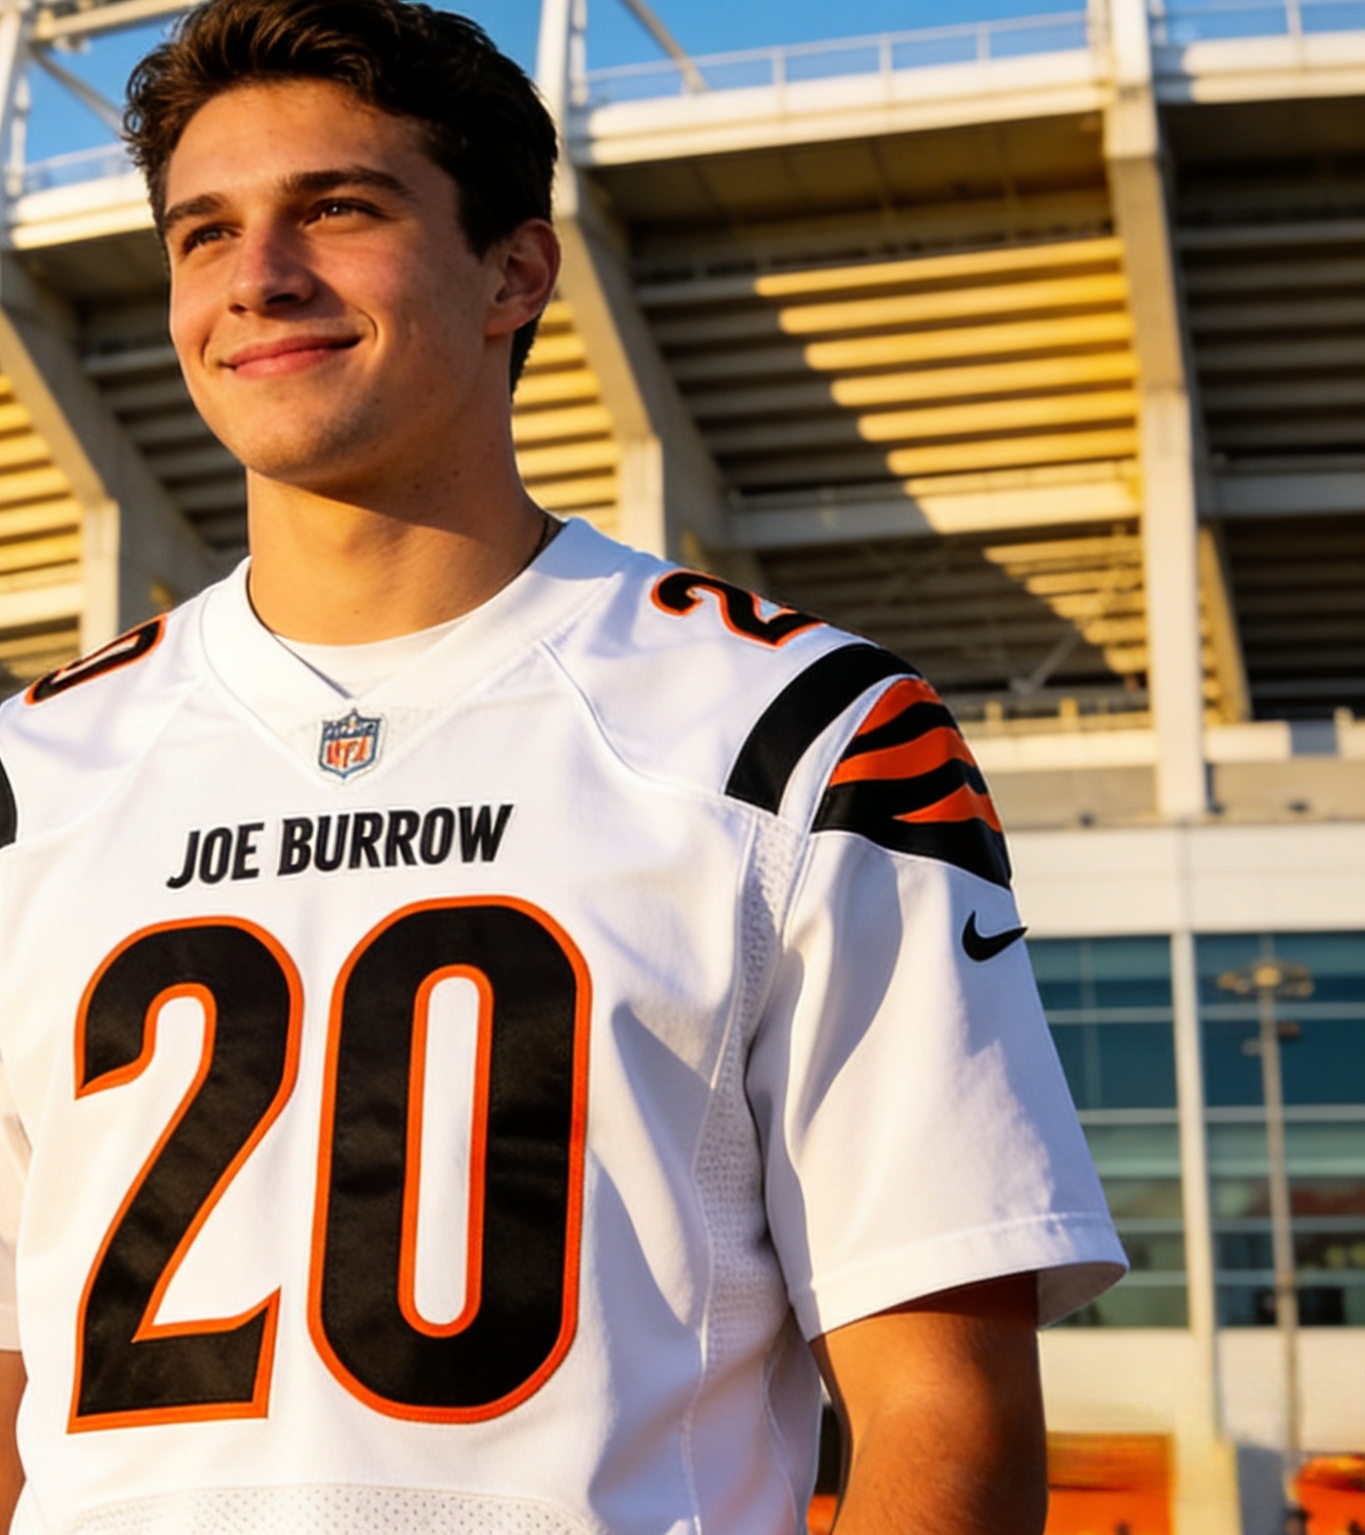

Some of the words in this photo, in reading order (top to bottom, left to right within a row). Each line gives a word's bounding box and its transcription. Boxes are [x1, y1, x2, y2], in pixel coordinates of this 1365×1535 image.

[166, 822, 265, 889] JOE
[277, 804, 514, 876] BURROW
[66, 895, 593, 1434] 20
